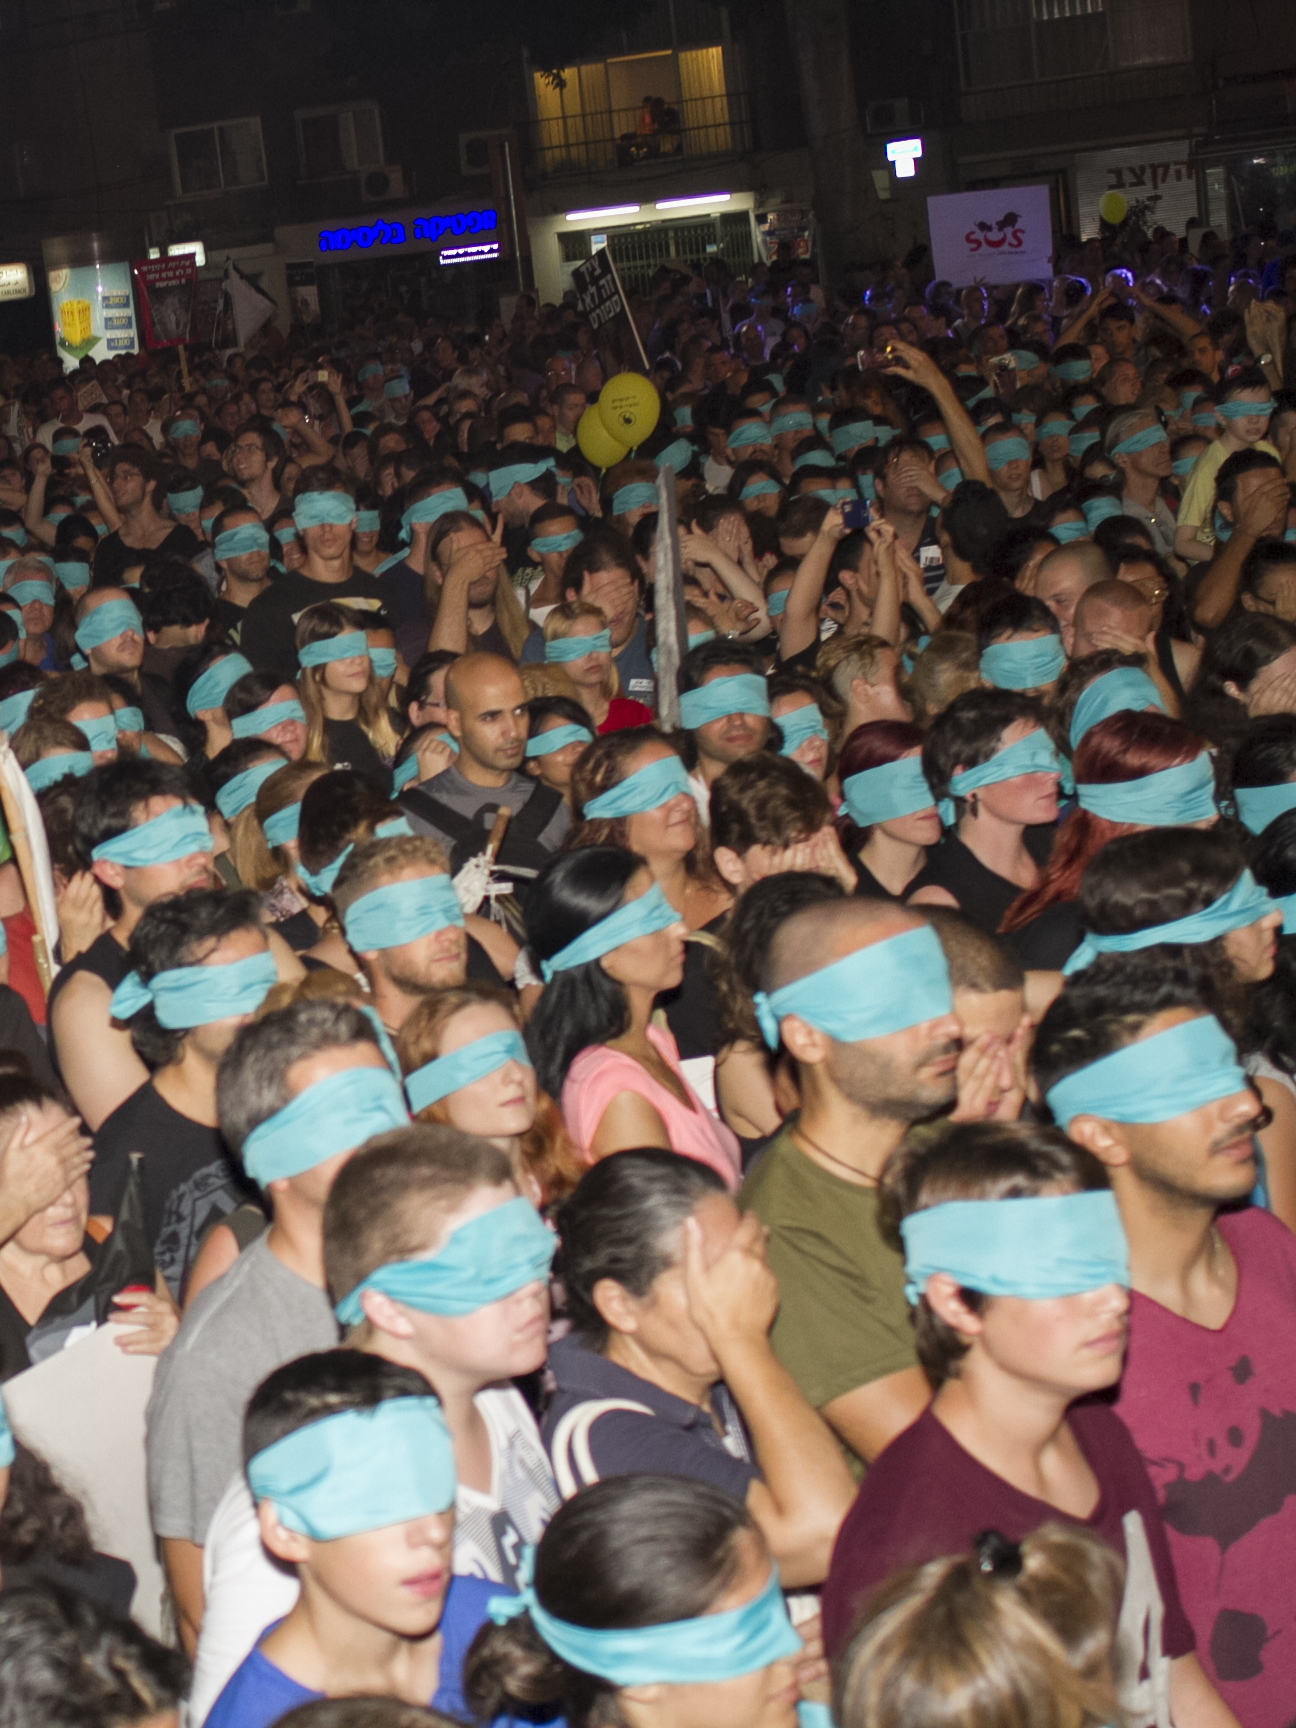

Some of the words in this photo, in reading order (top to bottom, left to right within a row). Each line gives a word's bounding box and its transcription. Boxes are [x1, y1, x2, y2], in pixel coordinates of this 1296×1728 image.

[1107, 160, 1193, 190] הקצב
[582, 285, 598, 312] לא
[598, 273, 615, 299] זה
[589, 294, 622, 330] ספורט
